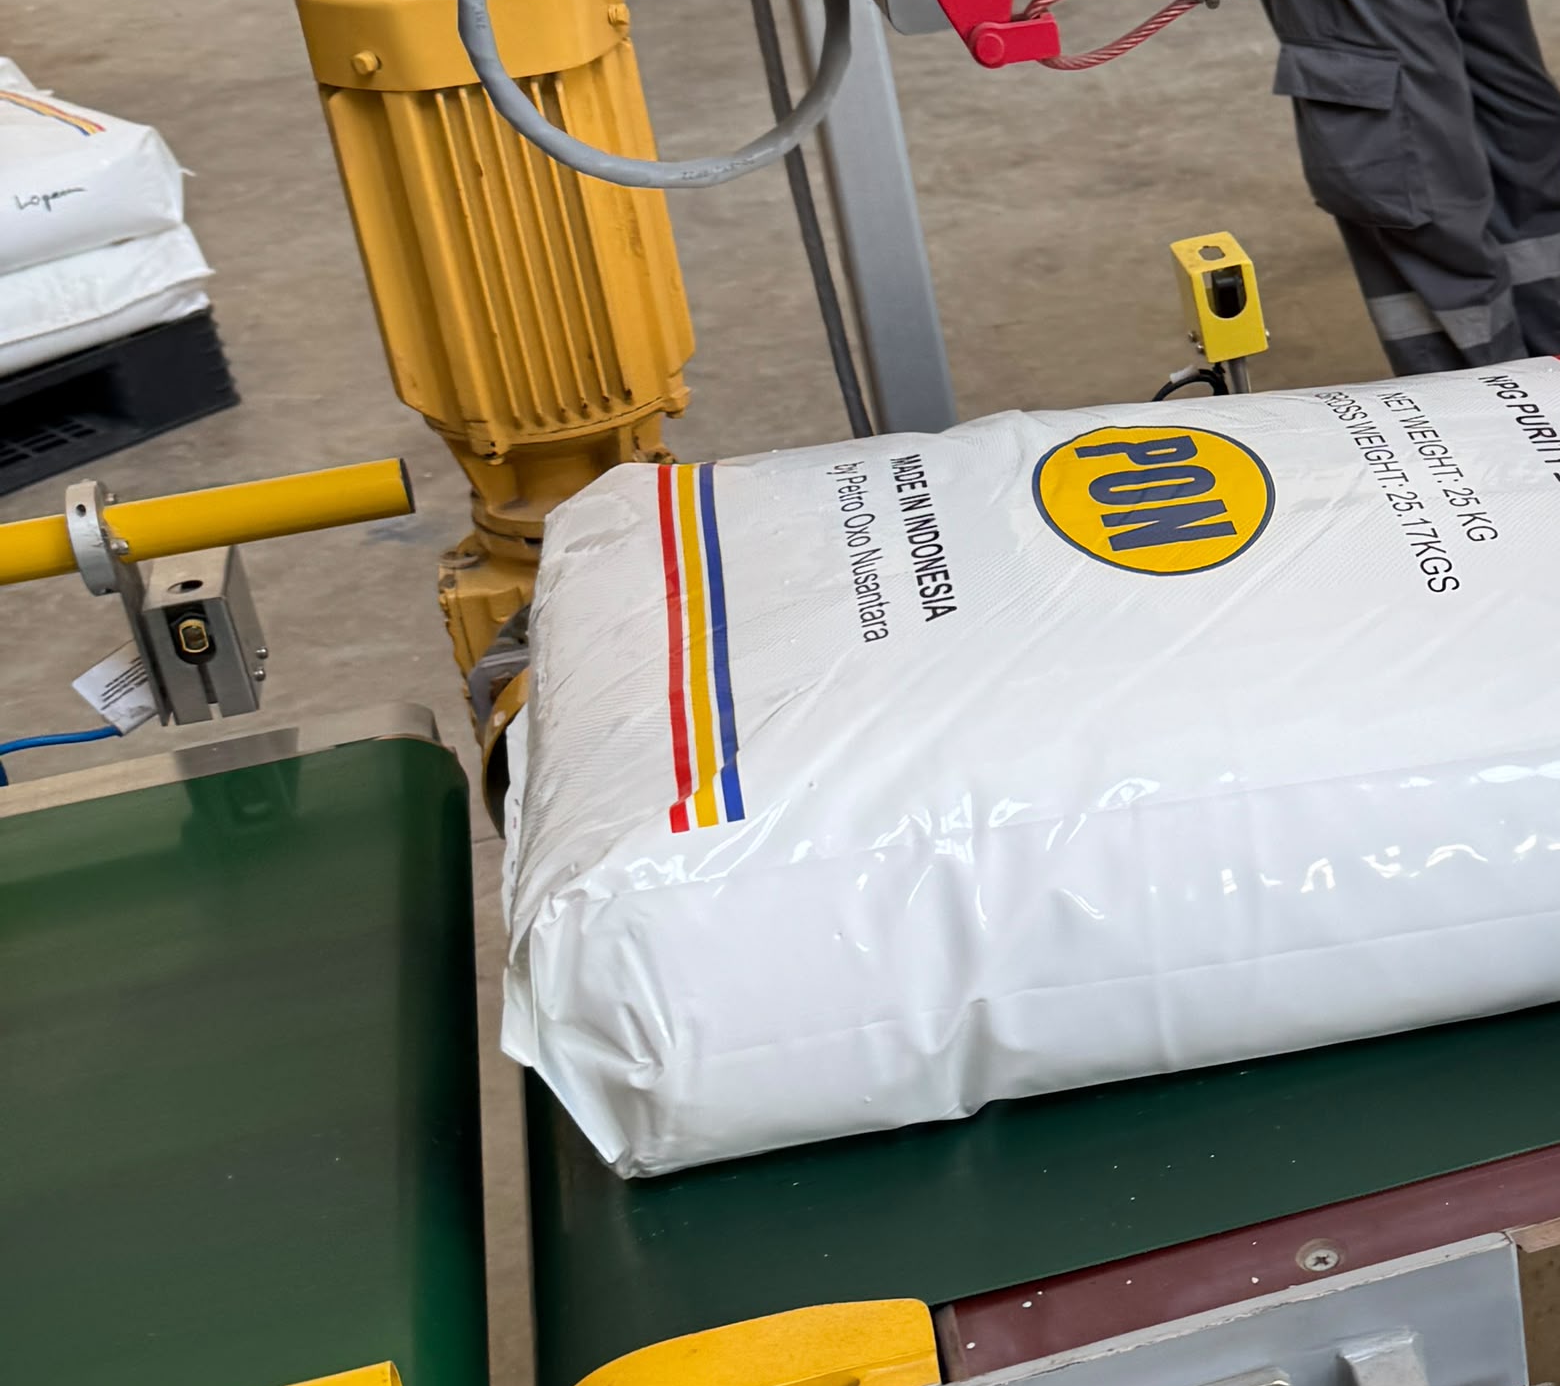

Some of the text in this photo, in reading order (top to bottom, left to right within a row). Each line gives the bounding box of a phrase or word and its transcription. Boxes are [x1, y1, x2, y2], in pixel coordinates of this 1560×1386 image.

[1377, 391, 1499, 543] NET WEIGHT: 25 KG
[1478, 375, 1529, 401] NPG
[826, 461, 890, 643] by Petro Oxo Nusantara
[890, 454, 958, 622] MADE IN INDONESIA
[1075, 435, 1238, 553] PON
[1315, 391, 1460, 594] GROSS WEIGHT: 25.17KGS
